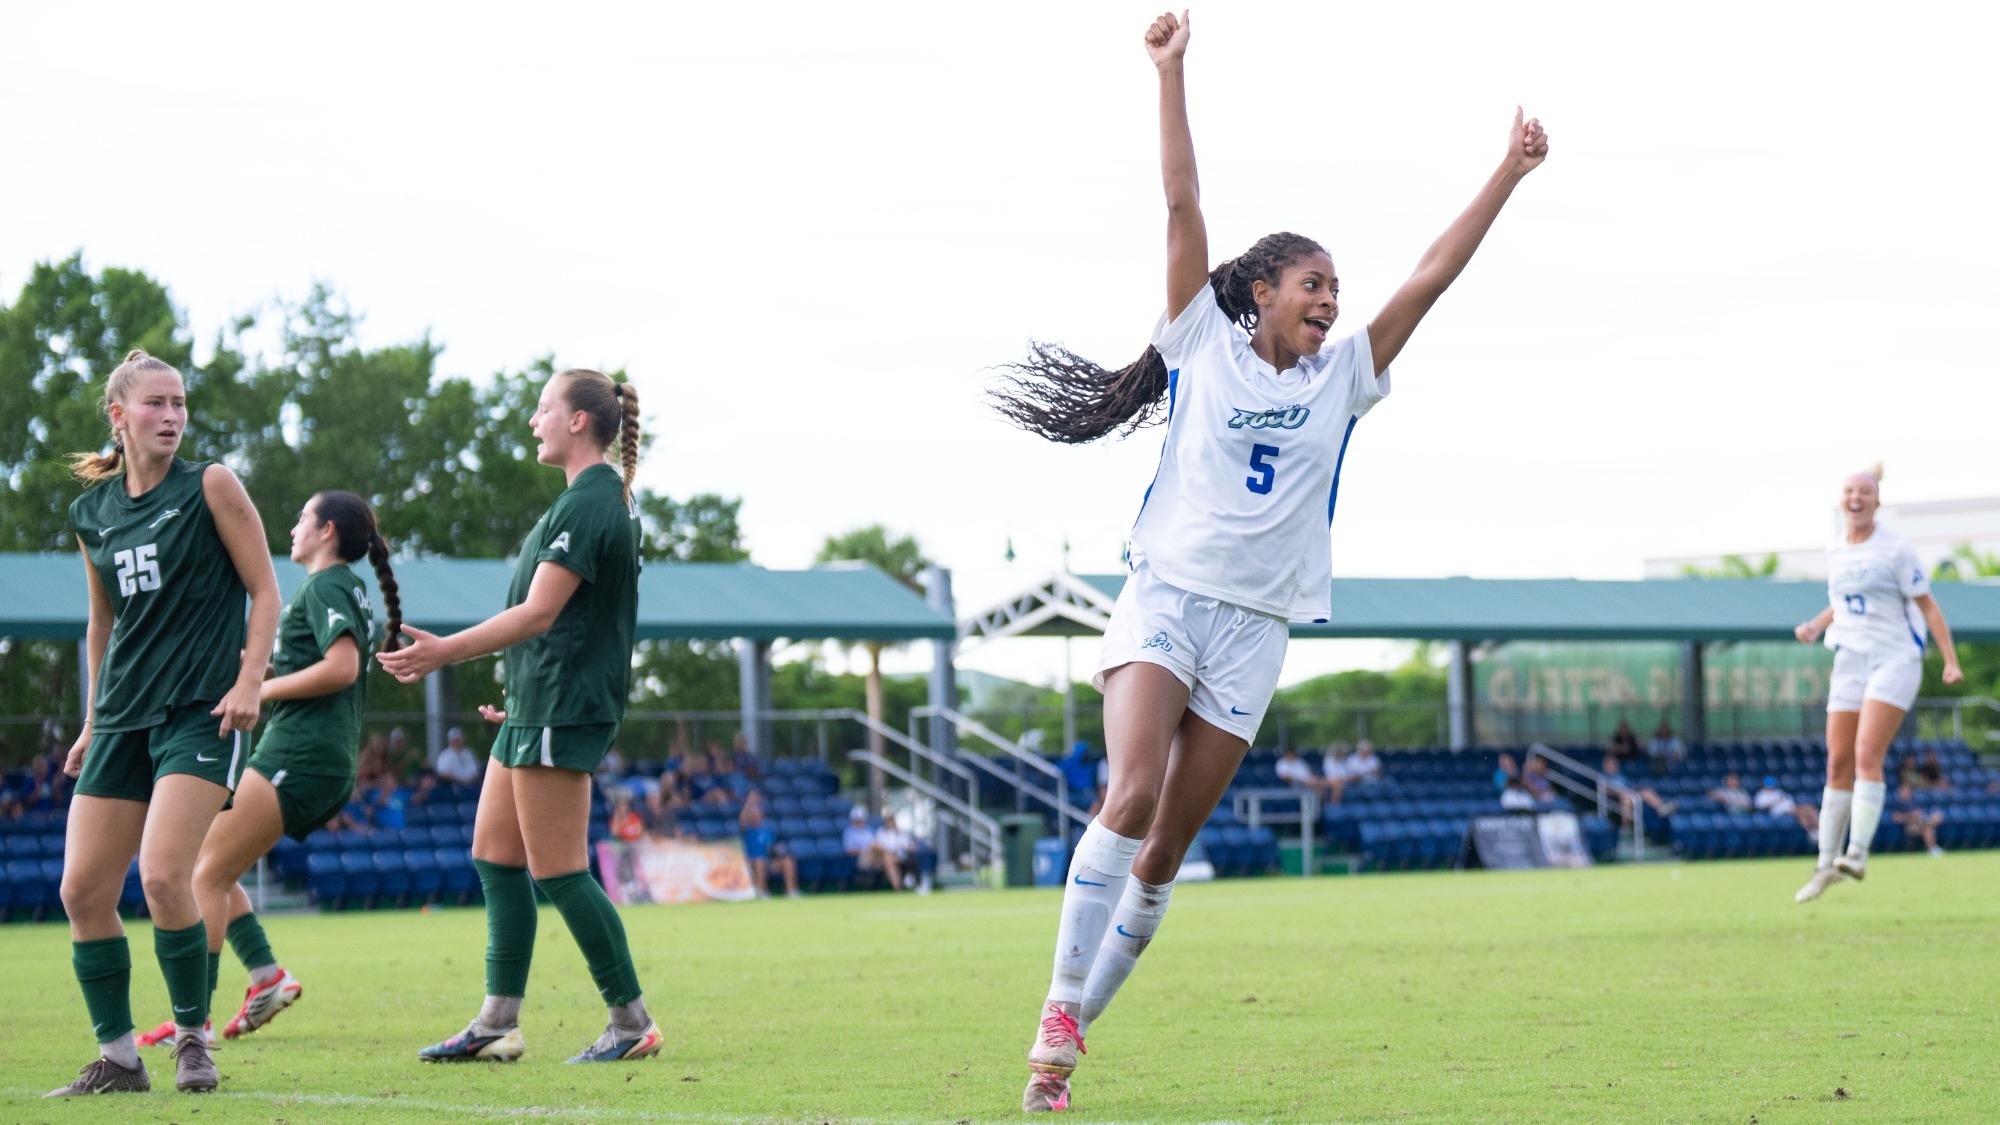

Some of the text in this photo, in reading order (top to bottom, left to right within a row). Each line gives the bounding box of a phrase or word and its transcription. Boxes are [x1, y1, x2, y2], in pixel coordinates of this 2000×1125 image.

[1246, 443, 1280, 495] 5
[114, 543, 161, 597] 25
[1844, 592, 1866, 616] 13
